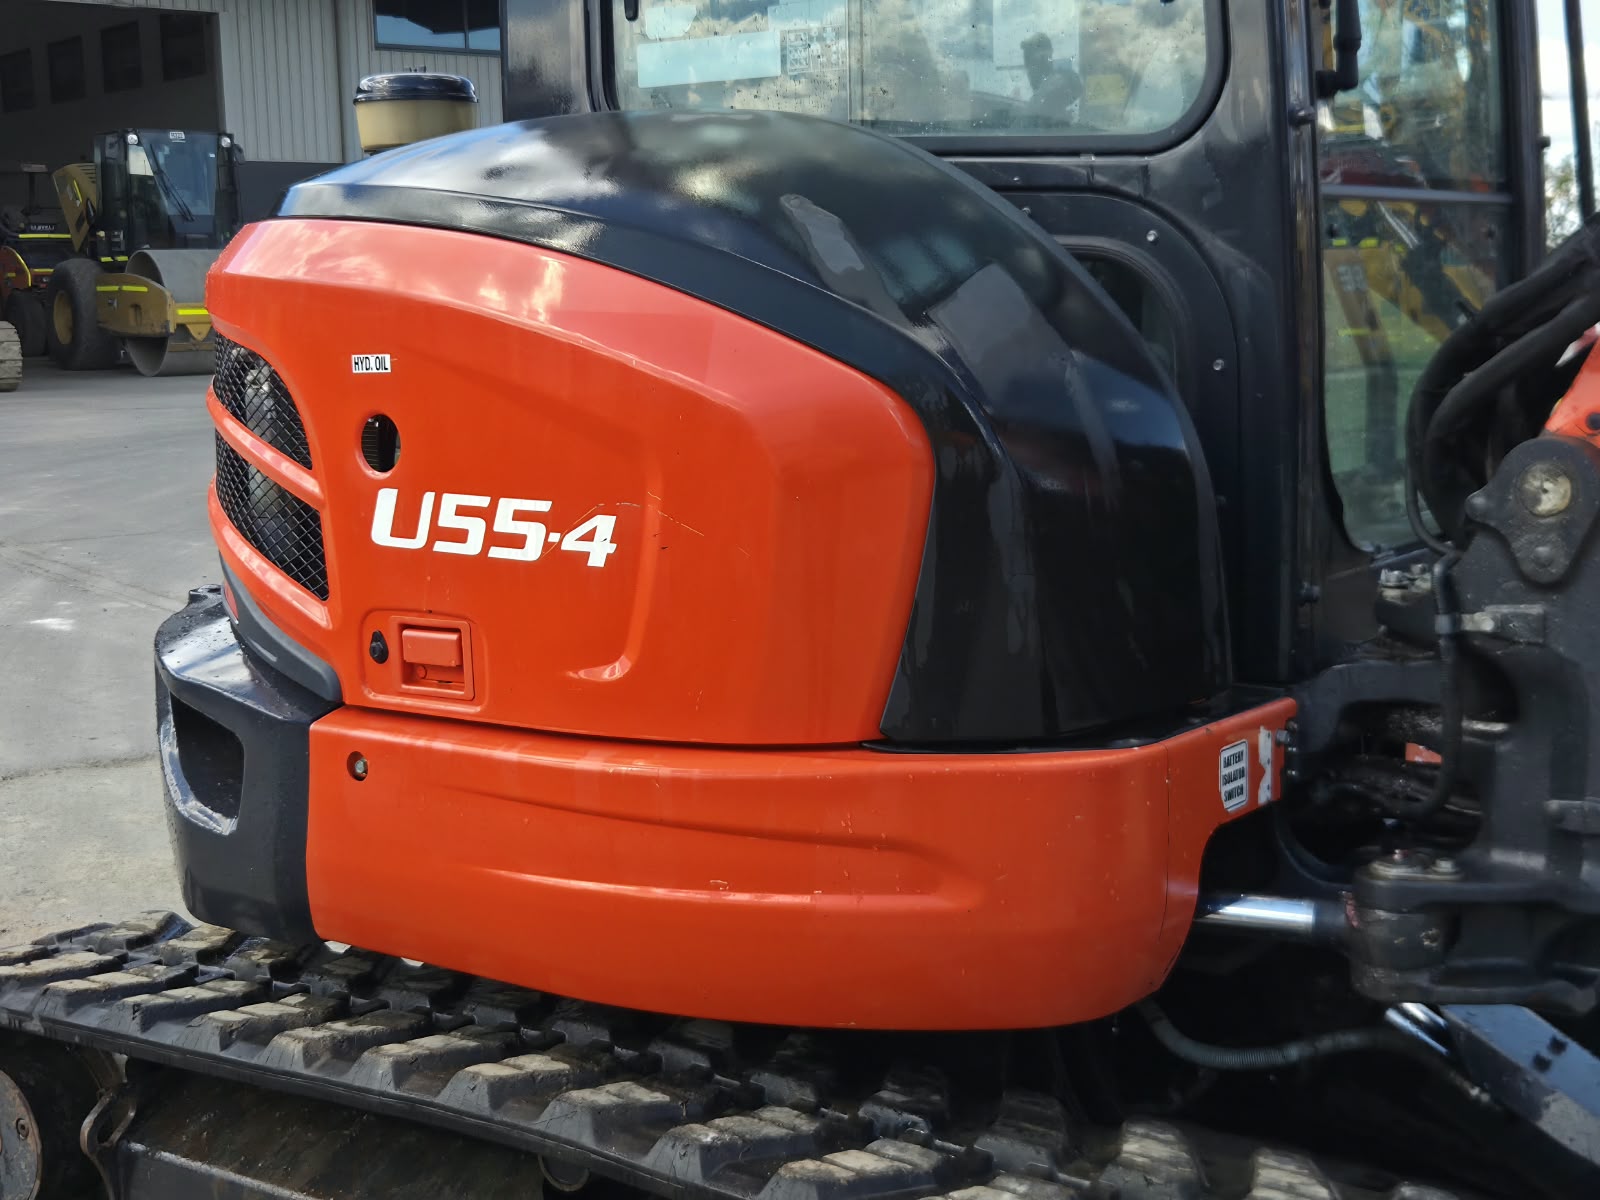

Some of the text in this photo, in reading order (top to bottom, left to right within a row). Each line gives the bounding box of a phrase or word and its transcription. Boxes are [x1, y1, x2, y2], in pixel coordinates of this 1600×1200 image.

[354, 356, 388, 370] HYD. OIL
[1223, 750, 1244, 768] BATTERY
[1222, 766, 1245, 786] ISOLATOR
[1224, 784, 1244, 802] SWITCH
